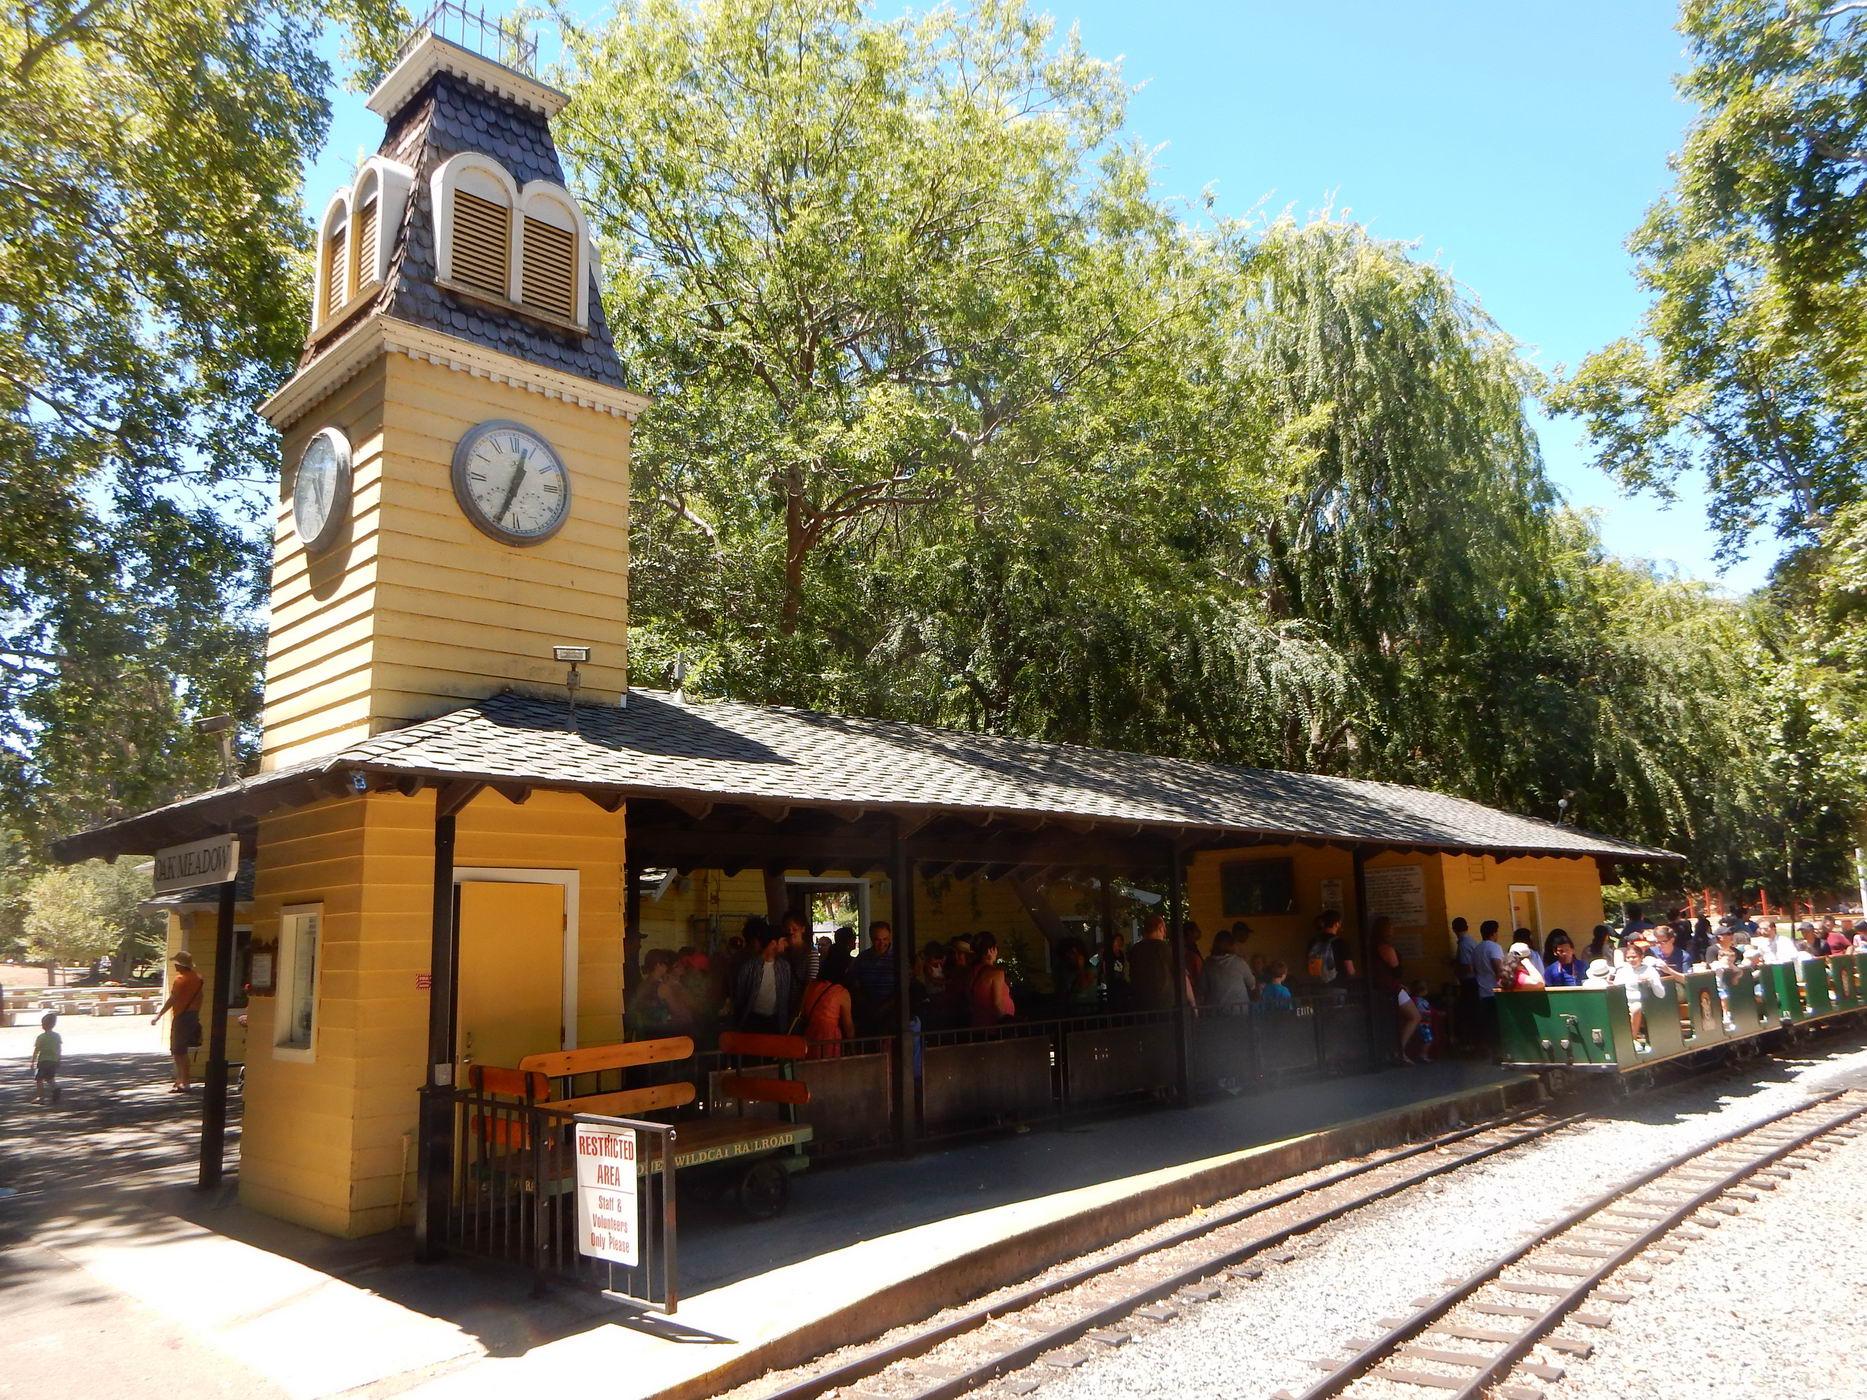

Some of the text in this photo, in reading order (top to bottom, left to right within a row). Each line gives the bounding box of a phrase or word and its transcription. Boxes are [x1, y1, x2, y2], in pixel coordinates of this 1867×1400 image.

[155, 844, 231, 881] OAK MEADOW
[578, 1135, 634, 1161] RESTRICTED
[734, 1134, 793, 1156] RALROAD
[597, 1164, 621, 1187] AREA
[598, 1194, 622, 1213] Staff &
[592, 1212, 628, 1233] Volunteers
[590, 1231, 630, 1254] Only Please
